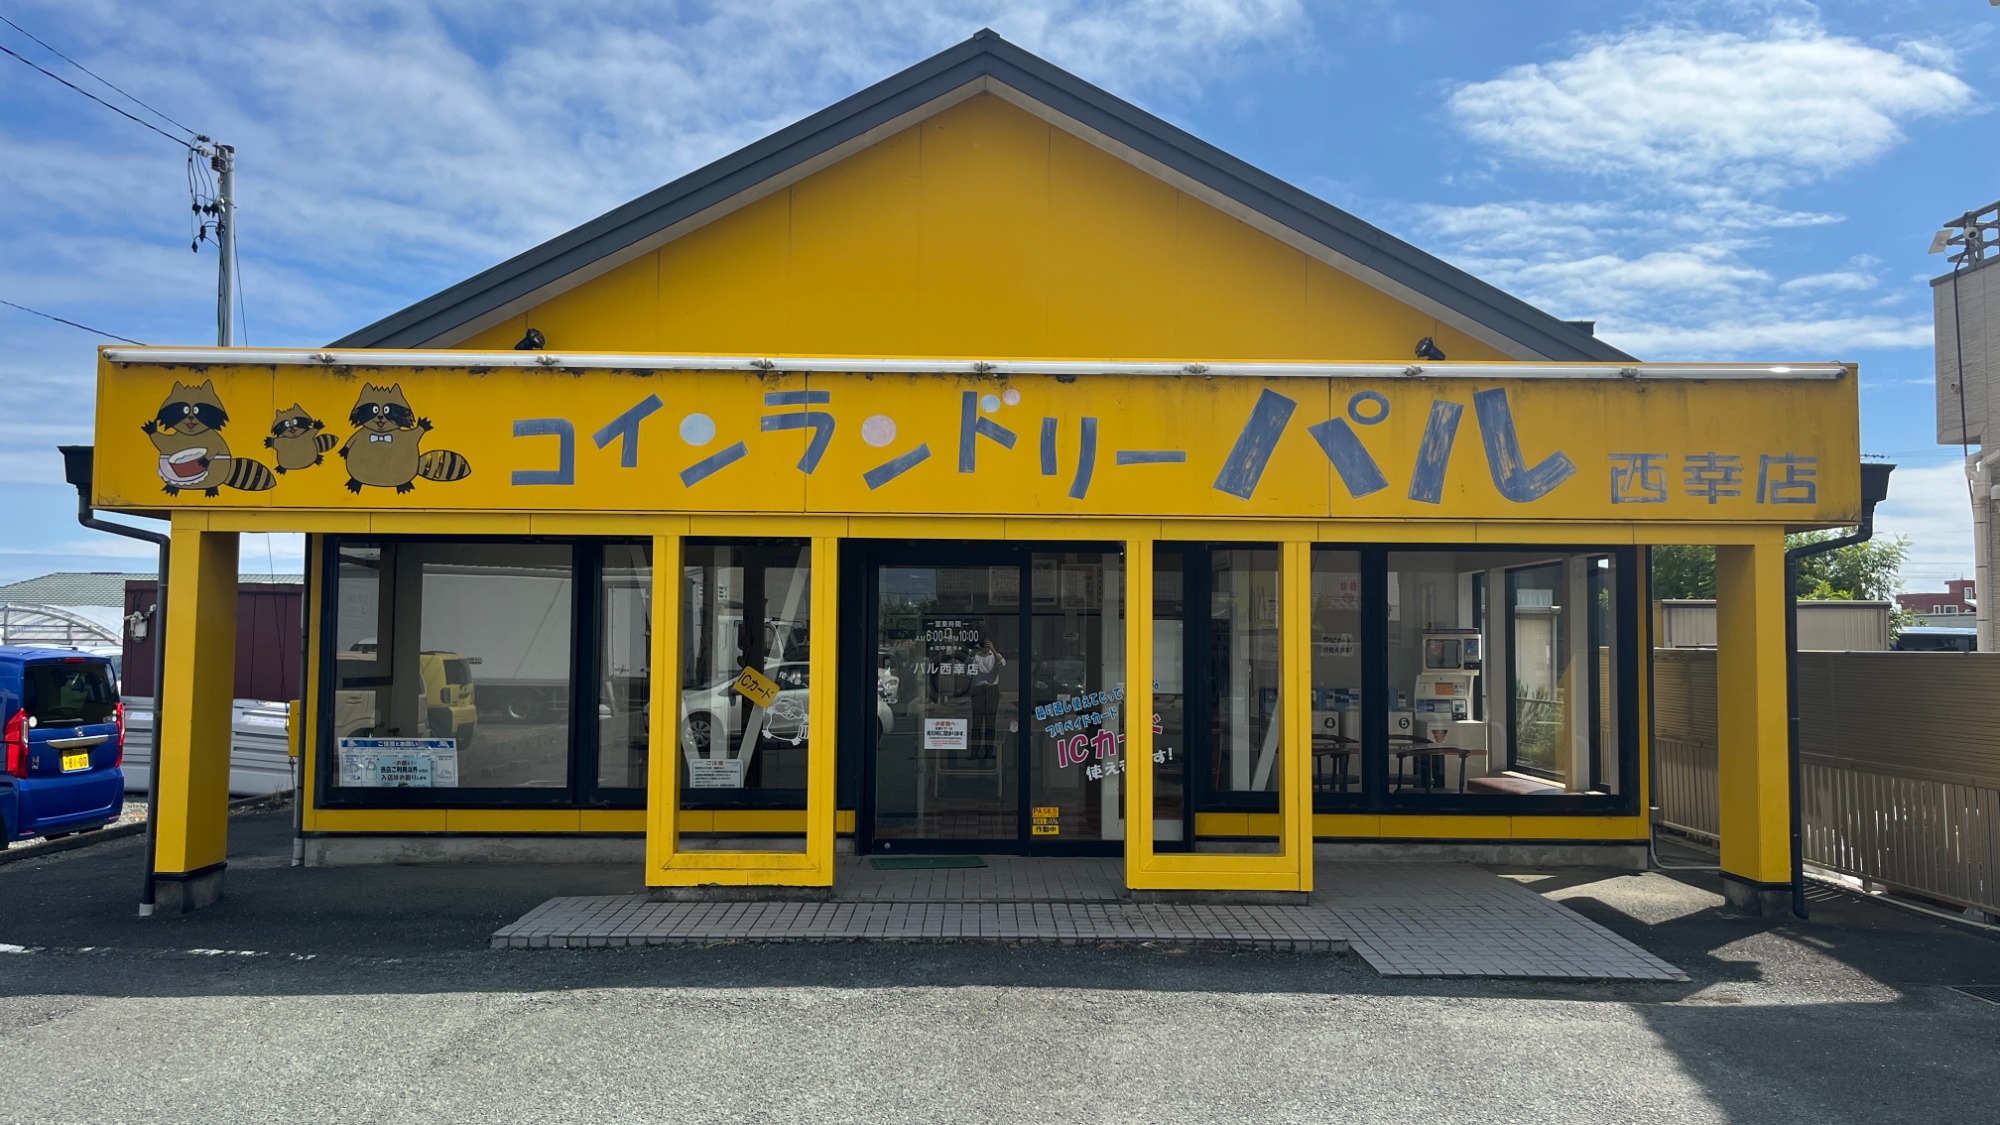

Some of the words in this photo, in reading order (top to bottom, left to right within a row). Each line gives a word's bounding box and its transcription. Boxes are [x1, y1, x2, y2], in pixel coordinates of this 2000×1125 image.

[512, 388, 1187, 500] コインランドリー
[1213, 387, 1578, 504] パル
[1608, 451, 1818, 506] 西幸店
[737, 671, 775, 700] ICカード
[1057, 713, 1163, 768] ICカ
[1085, 747, 1173, 781] 使えす!
